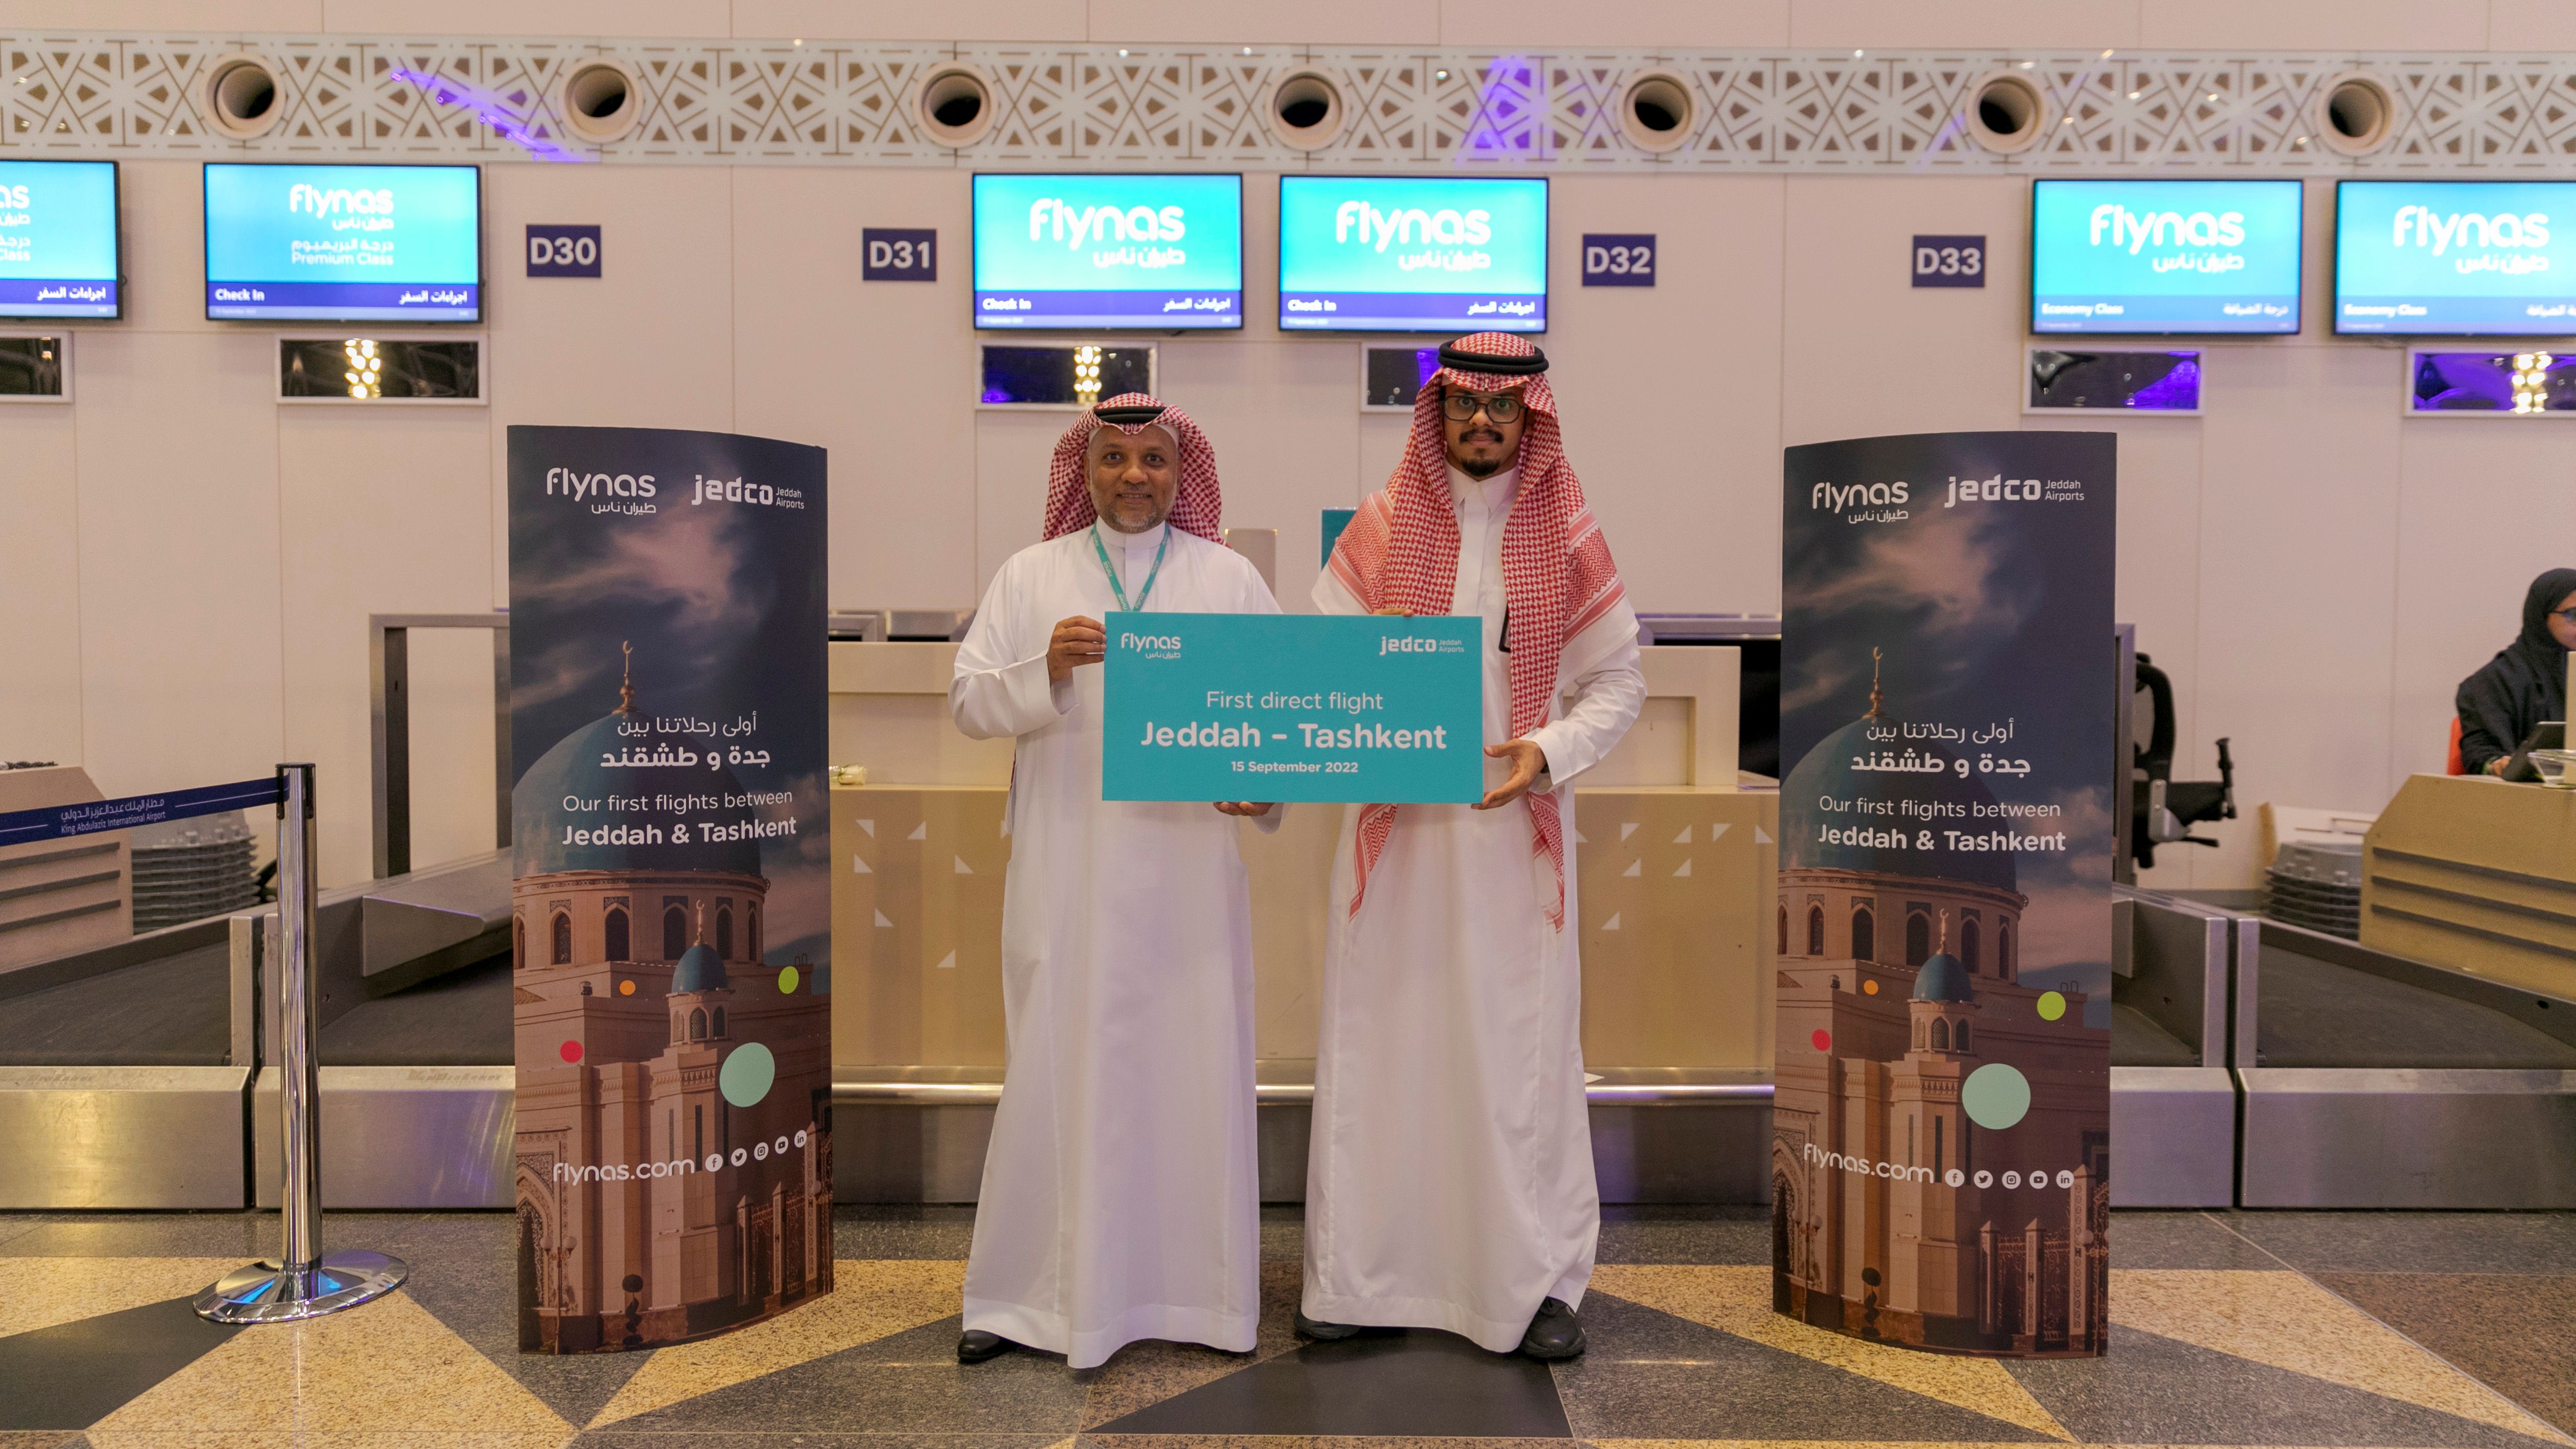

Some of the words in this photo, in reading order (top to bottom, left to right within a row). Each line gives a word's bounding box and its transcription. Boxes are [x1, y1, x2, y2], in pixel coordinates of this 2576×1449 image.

[290, 184, 394, 219] flynas
[1029, 197, 1186, 251] flynas
[1335, 200, 1491, 253] flynas
[2090, 203, 2246, 256] flynas
[2393, 205, 2550, 256] flynas
[292, 251, 354, 265] Premium
[356, 251, 394, 265] Class
[360, 239, 394, 254] درجة
[530, 237, 597, 265] D30
[869, 240, 930, 269] D31
[1586, 246, 1651, 274] D32
[1916, 247, 1982, 275] D33
[547, 467, 656, 502] flynas
[691, 474, 773, 505] jedco
[776, 487, 802, 499] Jeddah
[1944, 473, 2042, 508] jedco
[2045, 479, 2081, 490] Jeddah
[591, 501, 621, 515] ناس
[776, 498, 805, 510] Airports
[1812, 481, 1909, 513] flynas
[2045, 490, 2085, 503] Airports
[623, 502, 656, 516] طيران
[1848, 509, 1875, 524] ناس
[1876, 508, 1909, 523] طيران
[1121, 632, 1181, 652] flynas
[1380, 635, 1436, 656] jedco
[1438, 645, 1465, 654] Airports
[1145, 650, 1162, 659] ناس
[1162, 651, 1181, 660] طيران
[1206, 691, 1253, 709] First
[1260, 691, 1321, 709] direct
[1328, 692, 1384, 714] flight
[617, 719, 649, 737] بين
[656, 716, 716, 737] رحلاتنا
[722, 711, 756, 737] أولى
[1140, 721, 1261, 748] Jeddah
[1298, 723, 1447, 750] Tashkent
[1866, 723, 1897, 742] بين
[1903, 722, 1965, 743] رحلاتنا
[1972, 717, 2014, 744] أولى
[600, 742, 698, 768] طشقند
[707, 752, 722, 771] و
[728, 745, 771, 768] جدة
[1850, 748, 1945, 773] طشقند
[1978, 753, 2031, 779] جدة
[1231, 761, 1245, 772] 15
[1248, 761, 1321, 774] September
[1325, 762, 1359, 773] 2022
[1954, 758, 1970, 779] و
[563, 796, 601, 812] Our
[608, 795, 648, 811] first
[655, 794, 719, 814] flights
[724, 791, 793, 808] between
[1819, 796, 1851, 812] Our
[1856, 798, 1894, 815] first
[1900, 799, 1966, 821] flights
[1973, 801, 2061, 818] between
[562, 824, 663, 845] Jeddah
[671, 823, 689, 844] &
[698, 817, 797, 843] Tashkent
[1819, 823, 1907, 850] Jeddah
[1916, 830, 1935, 851] &
[1943, 830, 2066, 852] Tashkent
[553, 1159, 695, 1186] flynas.com
[1804, 1143, 1934, 1184] flynas.com
